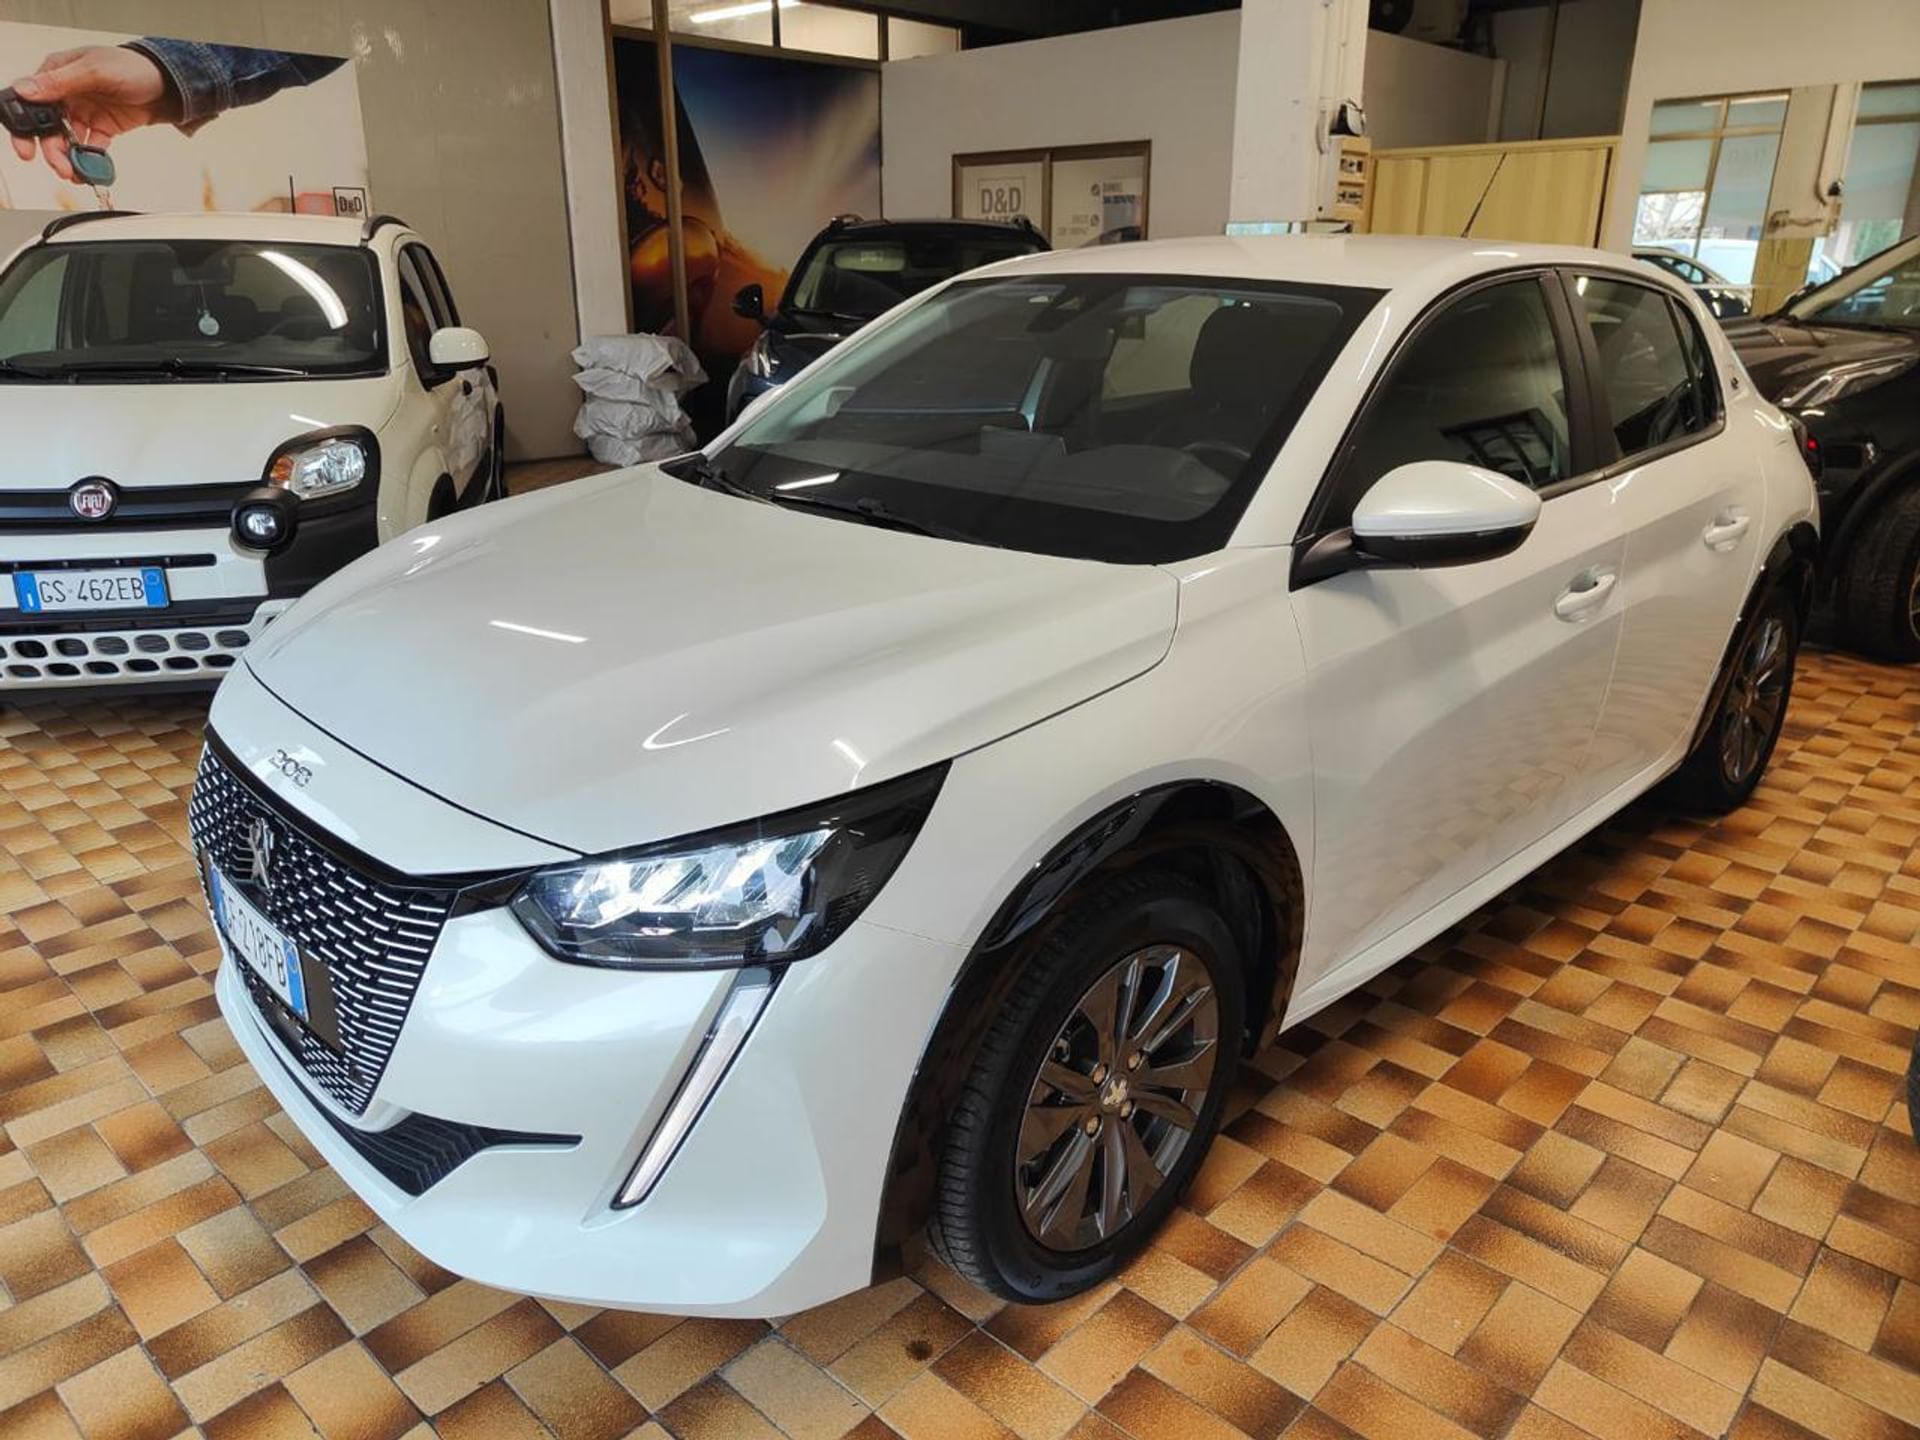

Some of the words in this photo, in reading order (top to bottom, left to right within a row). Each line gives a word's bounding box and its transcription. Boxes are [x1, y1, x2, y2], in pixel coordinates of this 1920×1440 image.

[981, 187, 1021, 214] D&D
[38, 580, 66, 603] GS
[77, 577, 145, 602] 462EB
[268, 749, 312, 787] 208
